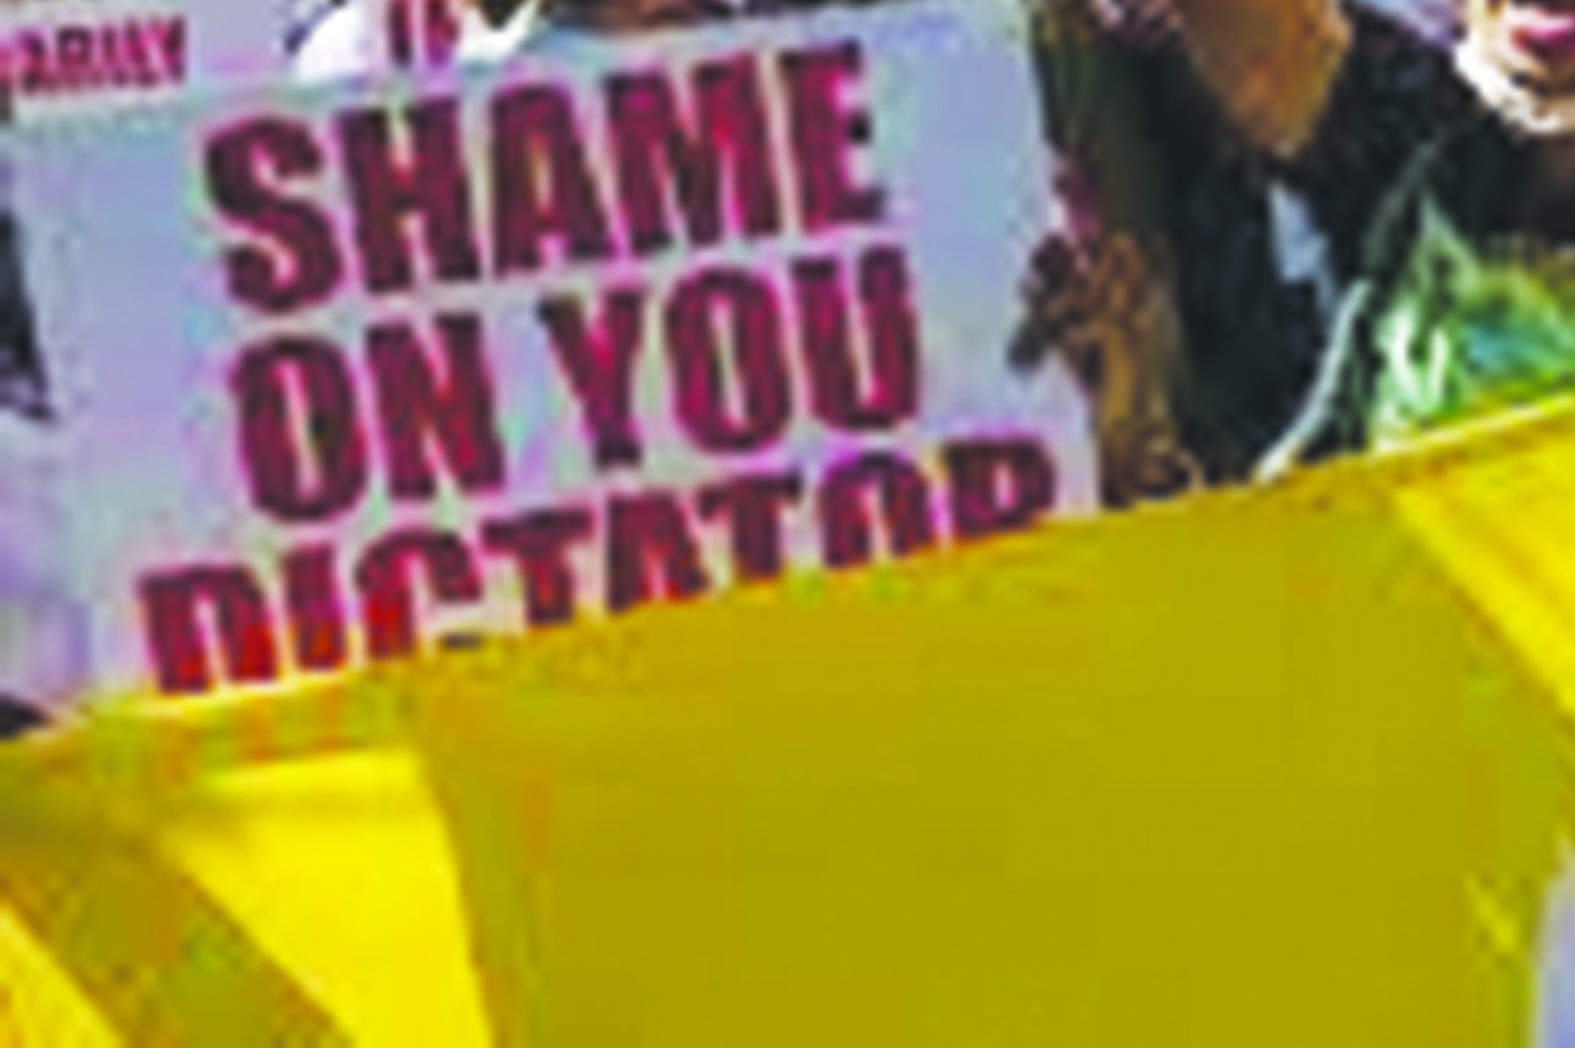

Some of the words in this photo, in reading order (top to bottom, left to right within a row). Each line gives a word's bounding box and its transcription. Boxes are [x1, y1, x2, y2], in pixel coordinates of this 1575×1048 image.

[204, 36, 884, 314] SHAME
[228, 310, 504, 524] ON
[536, 246, 922, 468] YOU
